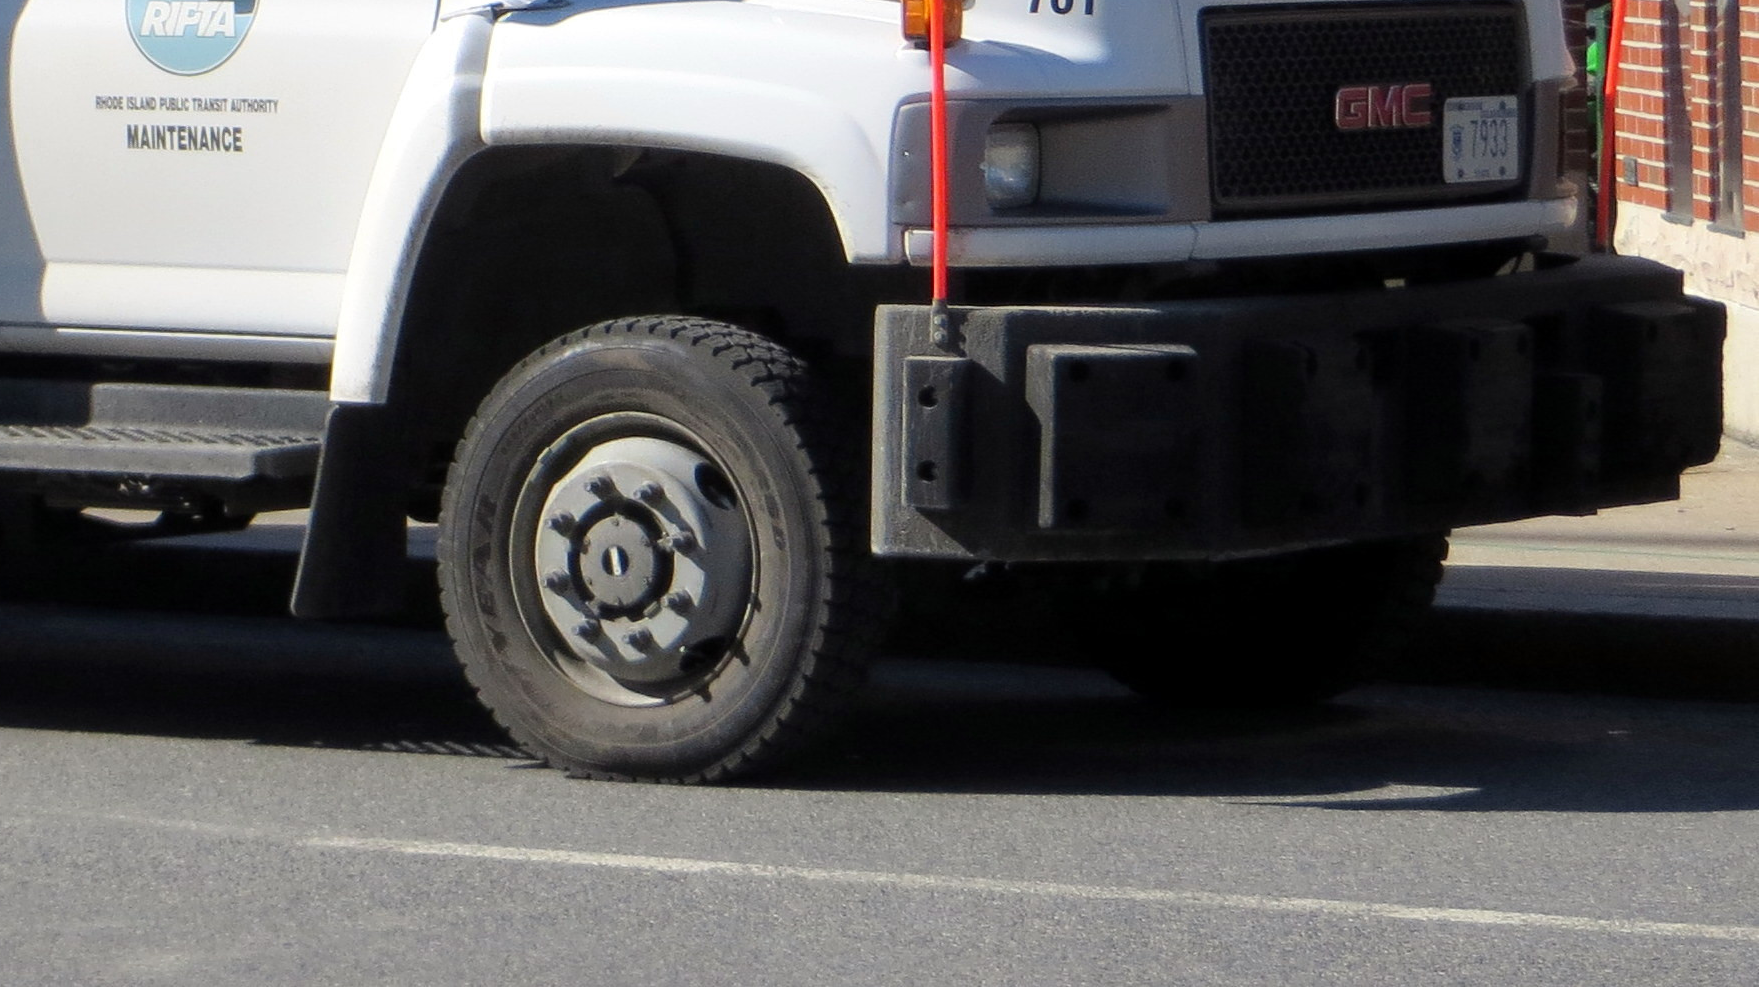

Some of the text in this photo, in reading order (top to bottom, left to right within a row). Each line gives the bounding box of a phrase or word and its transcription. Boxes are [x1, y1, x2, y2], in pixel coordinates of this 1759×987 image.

[139, 0, 237, 38] RIPTA
[95, 95, 279, 114] RHODE ISLAND PUBLIC TRANSIT AUTHORITY
[1335, 83, 1433, 130] GMC
[126, 124, 244, 153] MAINTENANCE
[1469, 118, 1509, 159] 7933
